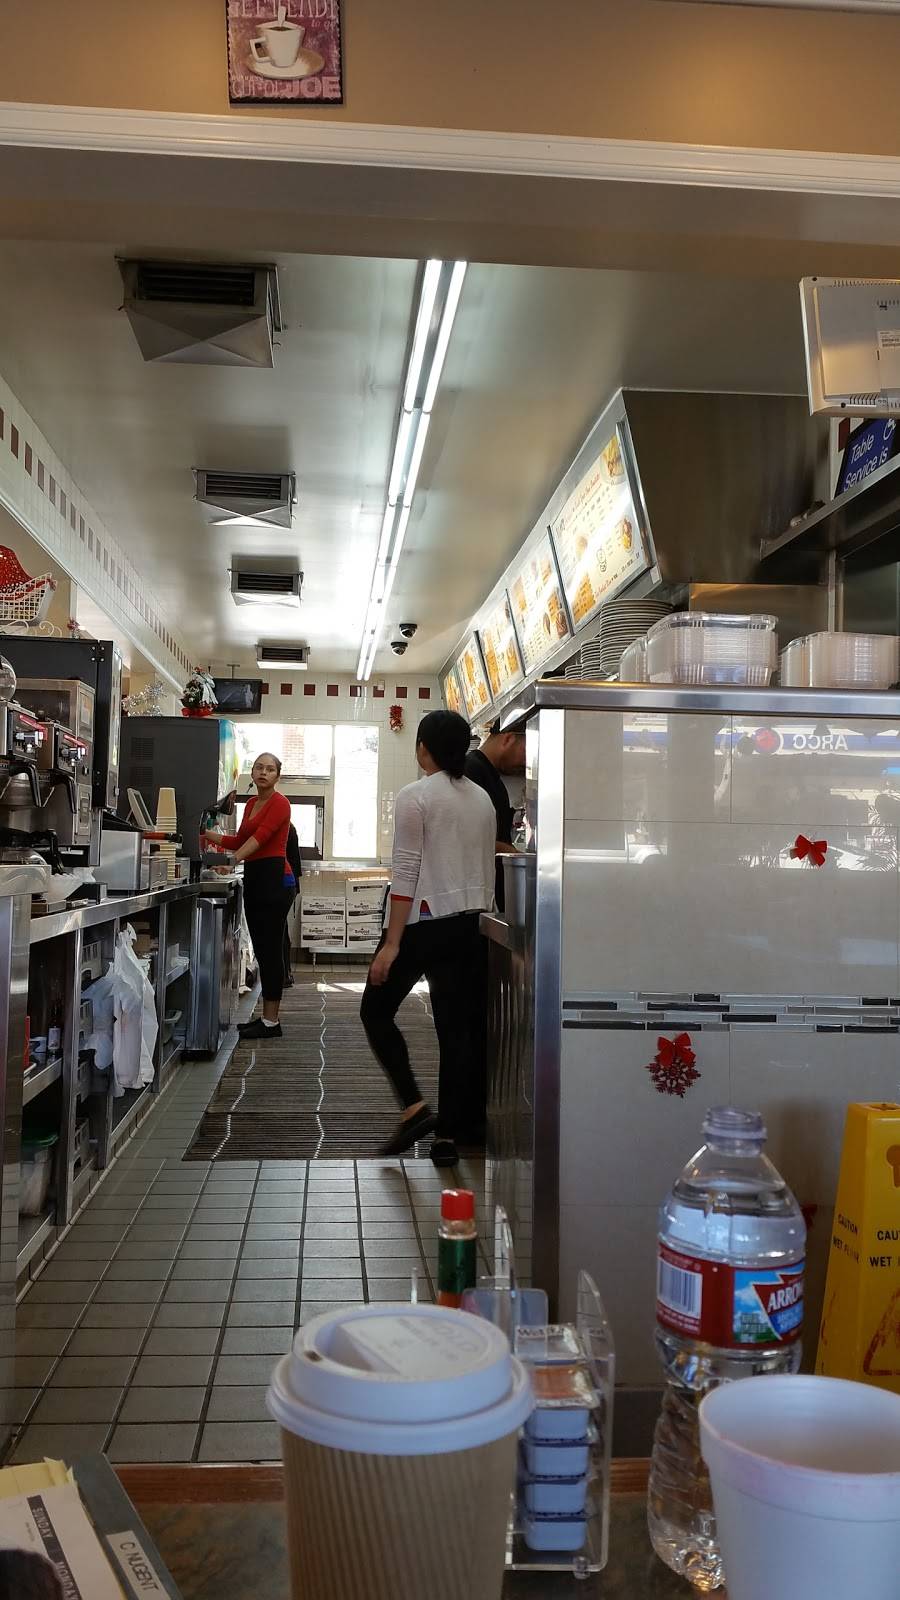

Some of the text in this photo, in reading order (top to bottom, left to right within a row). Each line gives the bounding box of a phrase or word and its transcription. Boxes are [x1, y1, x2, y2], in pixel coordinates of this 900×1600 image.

[284, 76, 341, 98] JOE
[851, 434, 875, 464] Table
[844, 446, 889, 492] Service is
[838, 1213, 858, 1236] CAUTION
[877, 1230, 900, 1241] CAU
[832, 1236, 843, 1249] WET
[869, 1256, 892, 1267] WET
[32, 1507, 54, 1538] SUNDAY
[120, 1541, 159, 1592] C NUGENT
